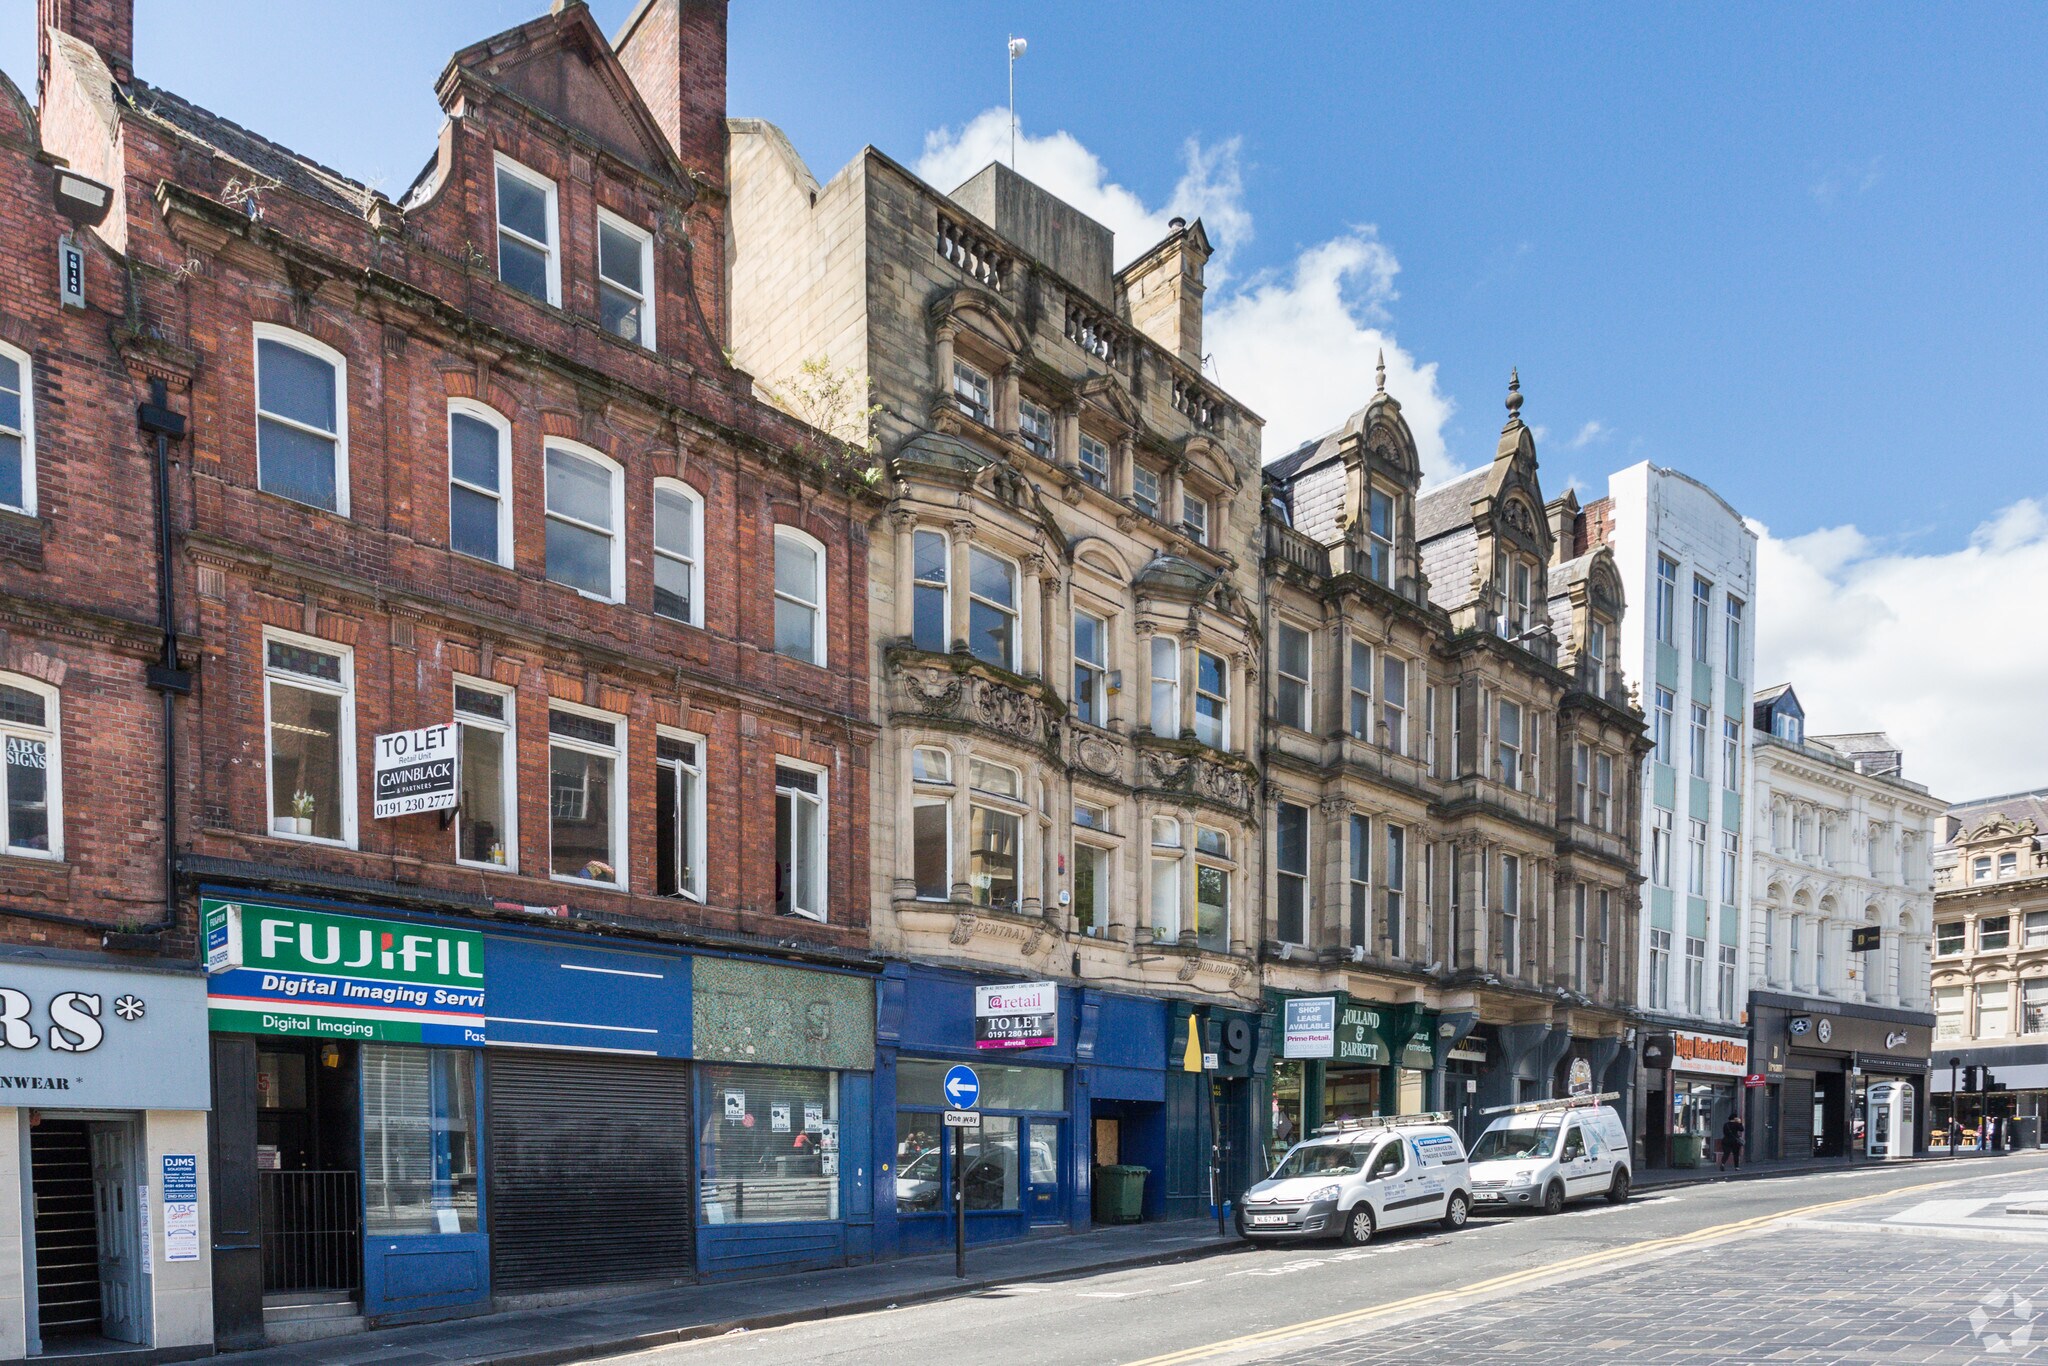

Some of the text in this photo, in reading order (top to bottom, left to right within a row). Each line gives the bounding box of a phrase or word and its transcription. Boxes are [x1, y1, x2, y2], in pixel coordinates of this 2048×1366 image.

[7, 737, 46, 756] ABC
[382, 727, 449, 757] TO LET
[7, 750, 47, 769] SIGNS
[399, 752, 432, 764] Retail Unit
[380, 762, 450, 787] GAVINBLACK
[402, 782, 432, 792] PARTNERS
[376, 793, 454, 816] 0191 230 2777
[976, 921, 1026, 941] CENTRAL
[1197, 961, 1239, 976] BUILDINGS
[261, 975, 337, 997] Digital
[342, 981, 428, 1006] Imaging
[989, 993, 1041, 1009] @retail
[262, 1014, 486, 1042] Digital Imaging Pas
[988, 1016, 1042, 1030] TO LET
[1288, 1023, 1330, 1031] AVAILABLE
[1225, 1018, 1251, 1066] 9
[1355, 1025, 1365, 1041] &
[1340, 1041, 1378, 1060] BARRETT
[1406, 1042, 1431, 1053] remedies
[1675, 1034, 1747, 1066] Bigg Market Chippy
[257, 1073, 270, 1092] 5
[946, 1113, 961, 1122] One
[165, 1158, 195, 1167] DJMS
[167, 1204, 195, 1213] ABC
